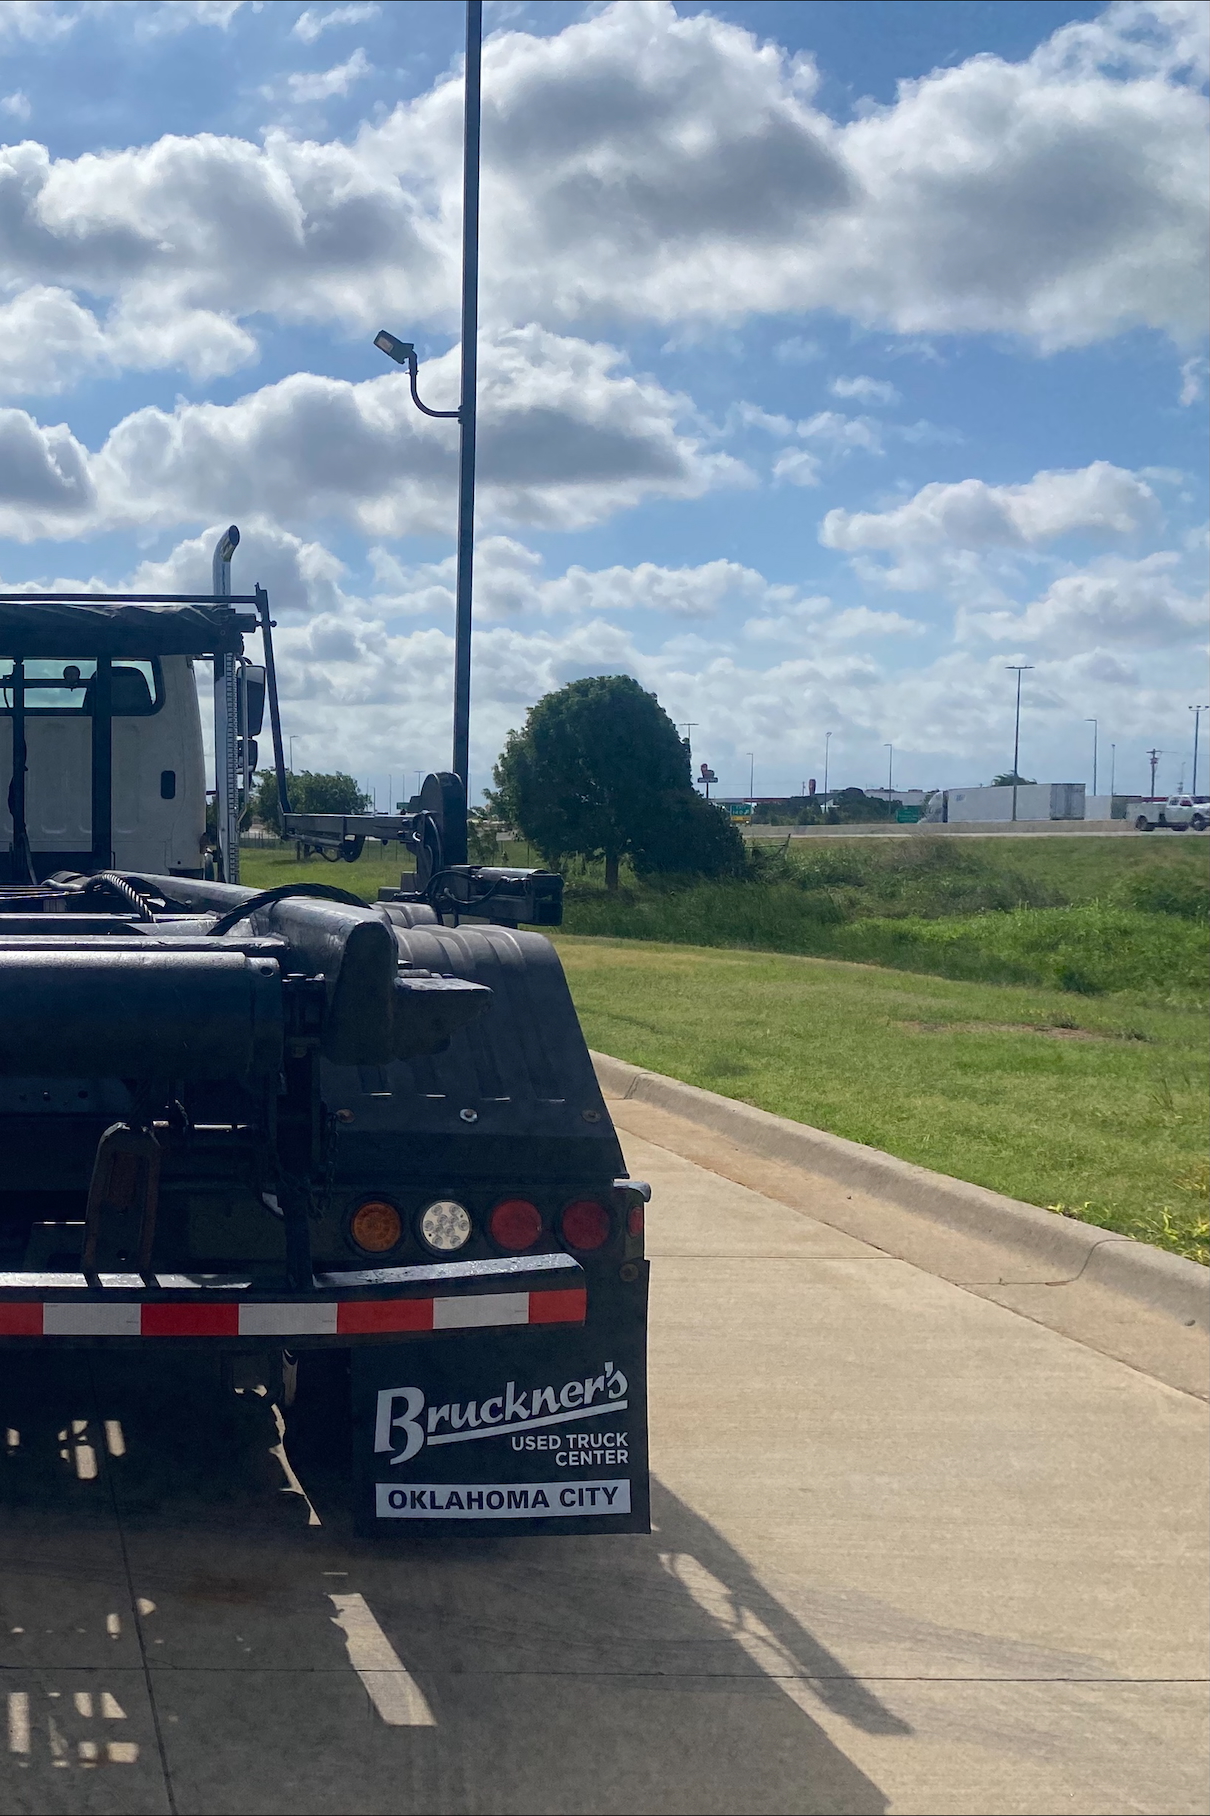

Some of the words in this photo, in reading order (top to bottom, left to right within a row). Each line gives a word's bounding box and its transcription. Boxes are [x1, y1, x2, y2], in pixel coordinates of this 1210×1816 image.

[374, 1361, 628, 1465] Bruckner's
[512, 1434, 562, 1451] USED
[566, 1431, 628, 1449] TRUCK
[555, 1450, 628, 1466] CENTER
[388, 1489, 550, 1511] OKLAHOMA
[559, 1486, 619, 1508] CITY
